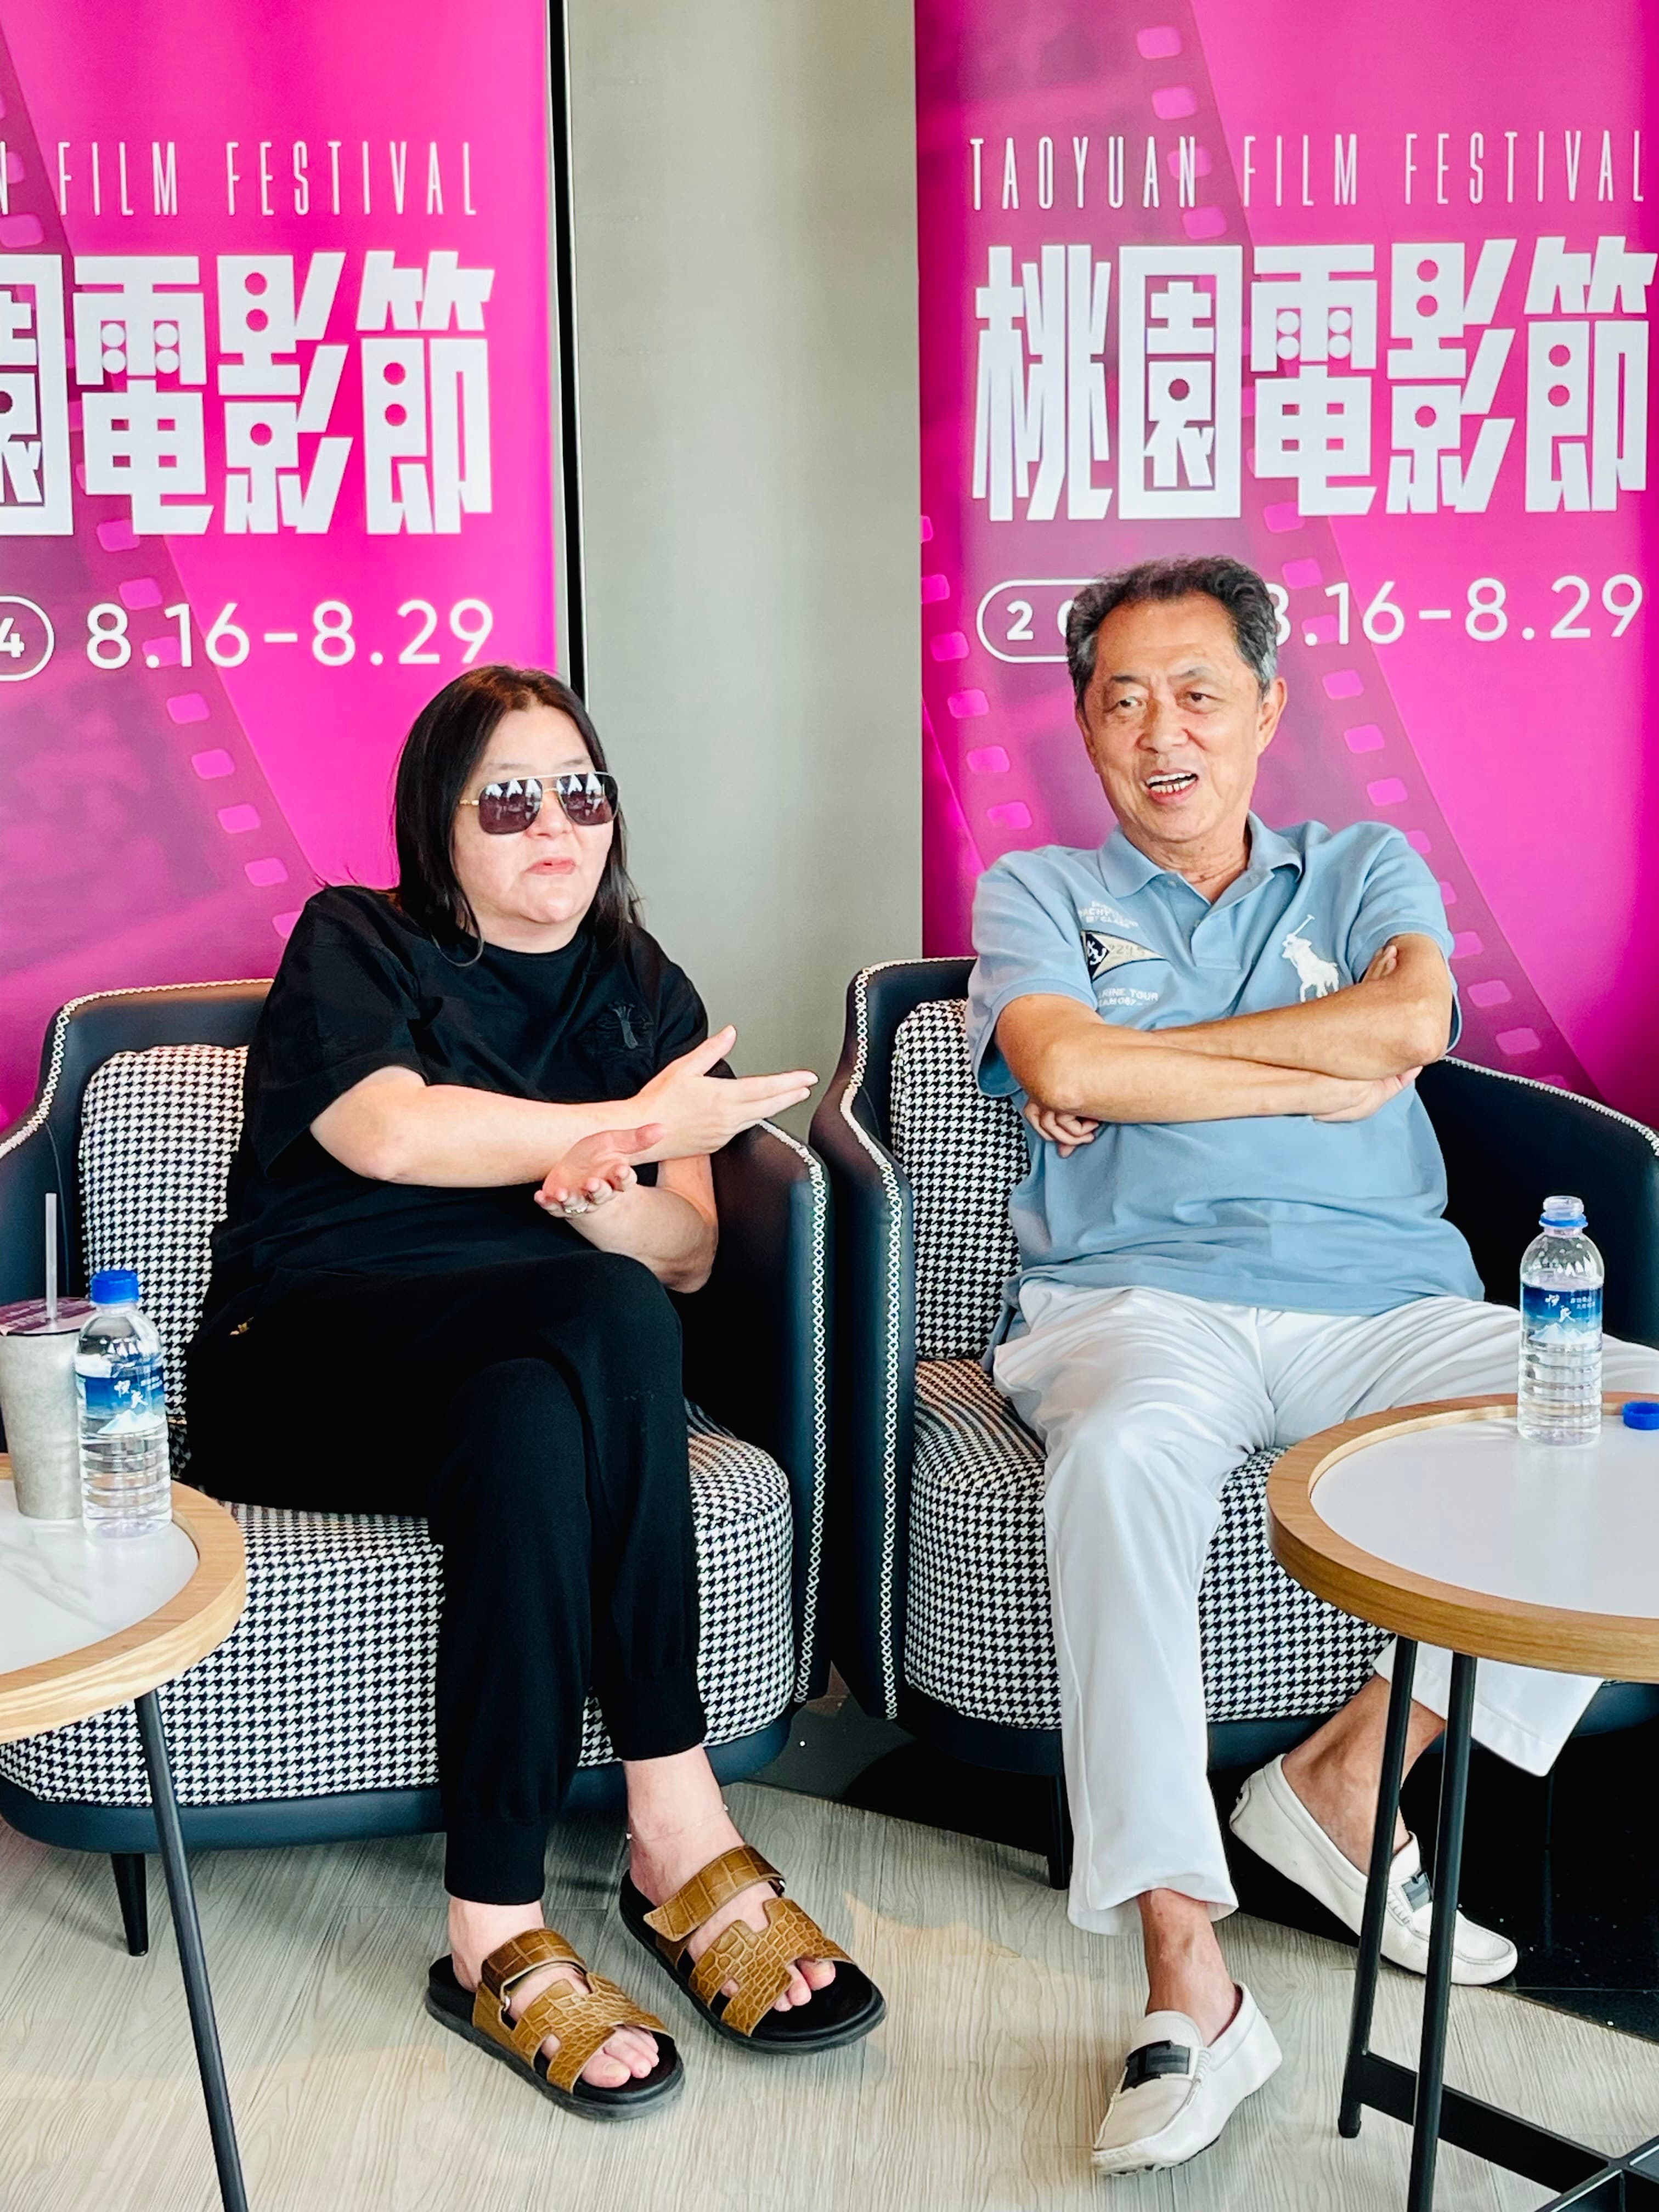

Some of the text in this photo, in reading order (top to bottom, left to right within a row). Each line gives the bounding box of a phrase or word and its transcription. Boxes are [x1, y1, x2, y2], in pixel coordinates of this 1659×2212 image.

[58, 142, 177, 215] FILM
[227, 141, 476, 215] FESTIVAL
[970, 130, 1643, 210] TAOYUAN FILM FESTIVAL
[972, 236, 1657, 522] 桃園電影節
[86, 598, 493, 669] 8.16-8.29
